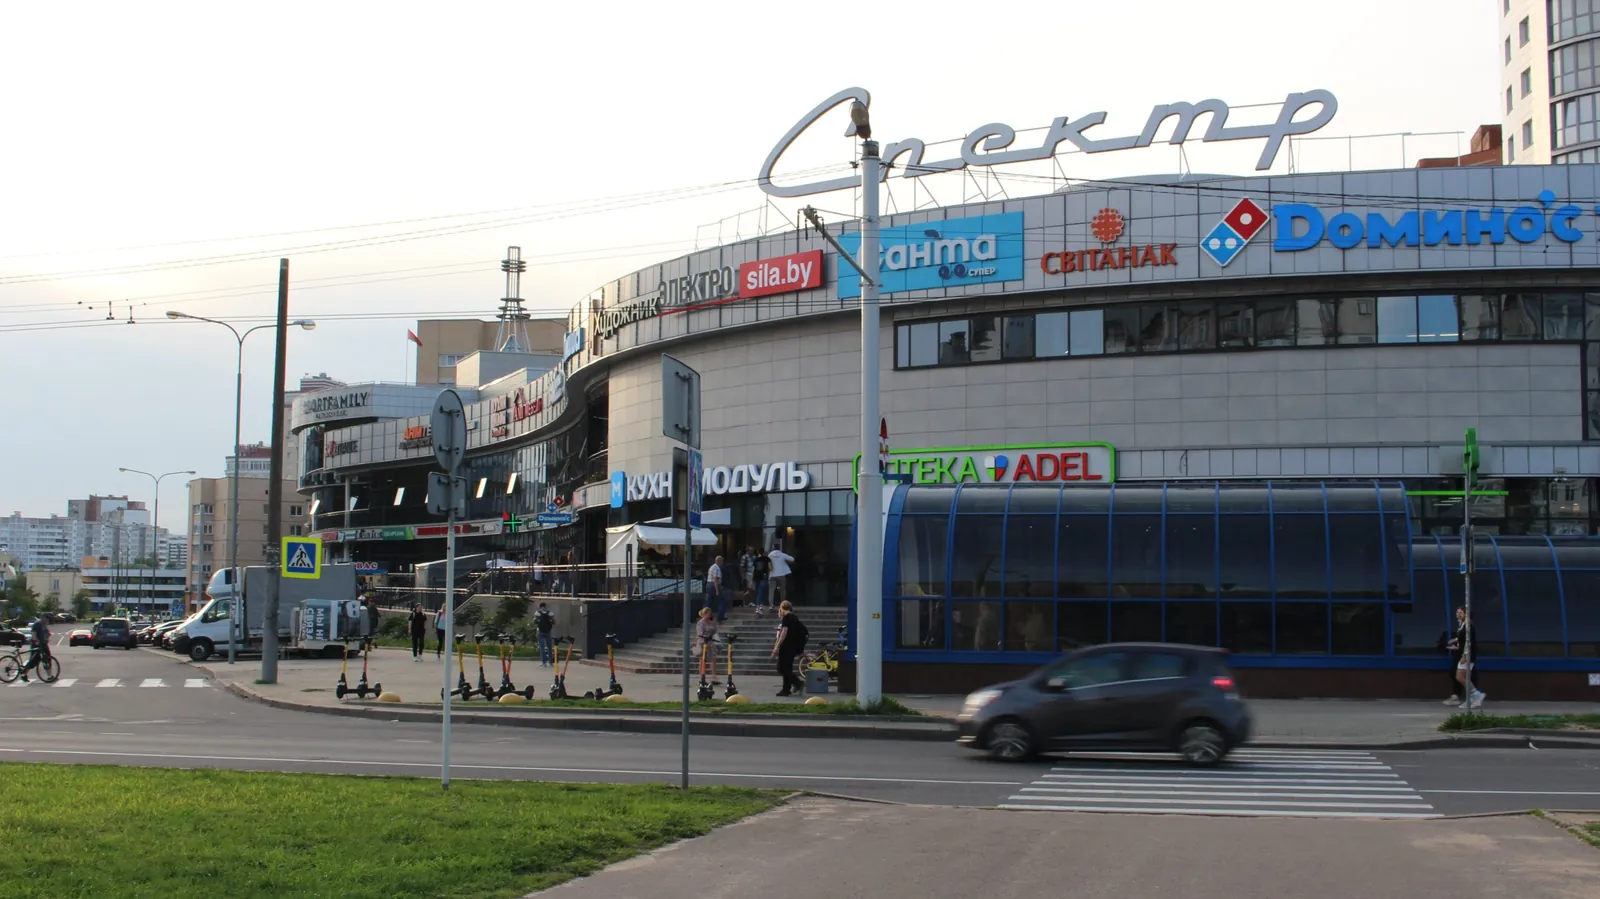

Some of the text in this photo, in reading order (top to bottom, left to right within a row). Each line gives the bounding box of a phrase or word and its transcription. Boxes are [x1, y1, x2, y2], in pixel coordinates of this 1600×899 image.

[758, 86, 1338, 198] Спектр
[746, 257, 813, 291] sila.by
[968, 267, 996, 277] СУПЕР
[1040, 243, 1178, 275] СВІТАНАК
[659, 265, 736, 306] ЭЛЕКТРО
[403, 424, 432, 440] ARMTE
[882, 452, 1102, 484] ПТЕКА ADEL
[626, 472, 673, 501] КУХН
